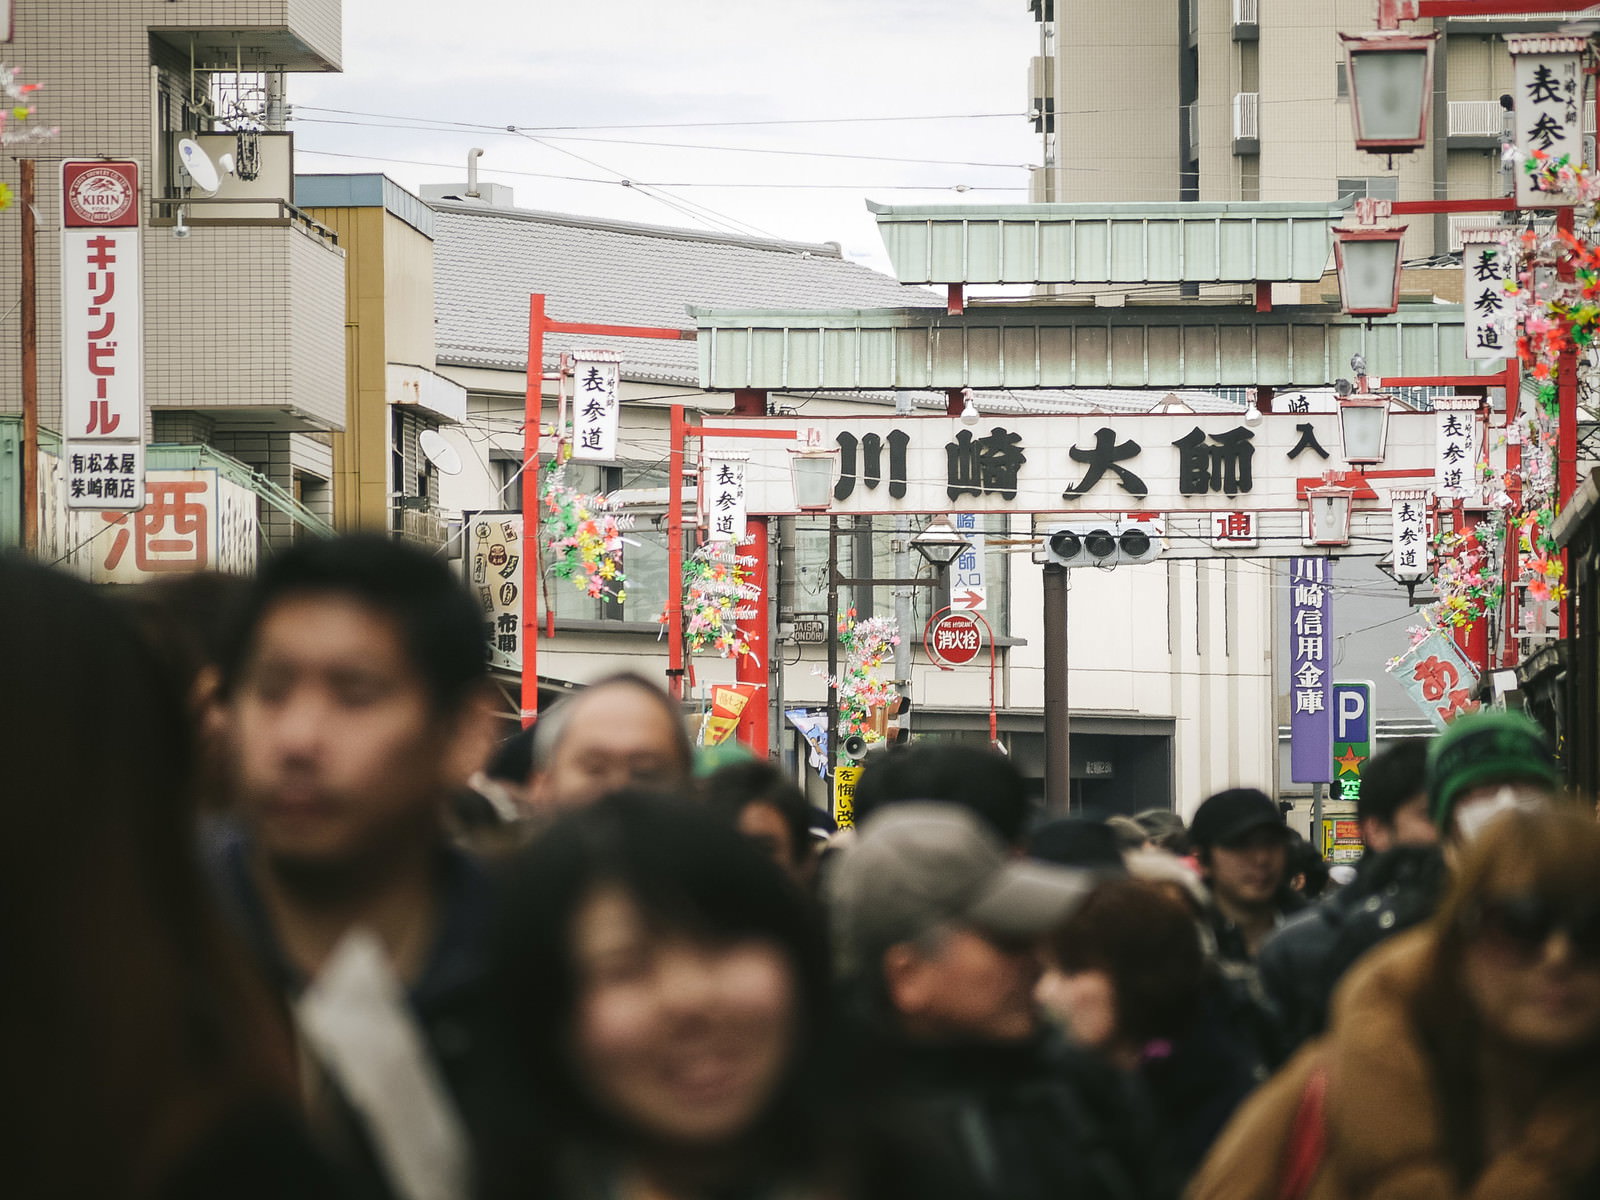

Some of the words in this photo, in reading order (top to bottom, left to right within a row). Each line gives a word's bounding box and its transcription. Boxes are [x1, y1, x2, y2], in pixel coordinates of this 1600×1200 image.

[82, 195, 119, 205] KIRIN
[1472, 250, 1504, 350] 表参道
[86, 235, 120, 435] キリンビール
[582, 366, 606, 450] 表参道
[834, 426, 1255, 500] 川崎大師
[1442, 414, 1465, 488] 表参道
[71, 478, 135, 498] 柴崎商店
[716, 463, 737, 535] 表参道
[101, 481, 208, 572] 酒
[1216, 512, 1252, 541] 通
[1398, 503, 1418, 567] 表参道
[954, 573, 981, 587] 入口
[793, 631, 823, 641] ONDORI
[938, 629, 978, 650] 消火栓
[1294, 557, 1325, 715] 川崎信用金庫
[1339, 691, 1365, 738] P
[1341, 779, 1362, 800] 空
